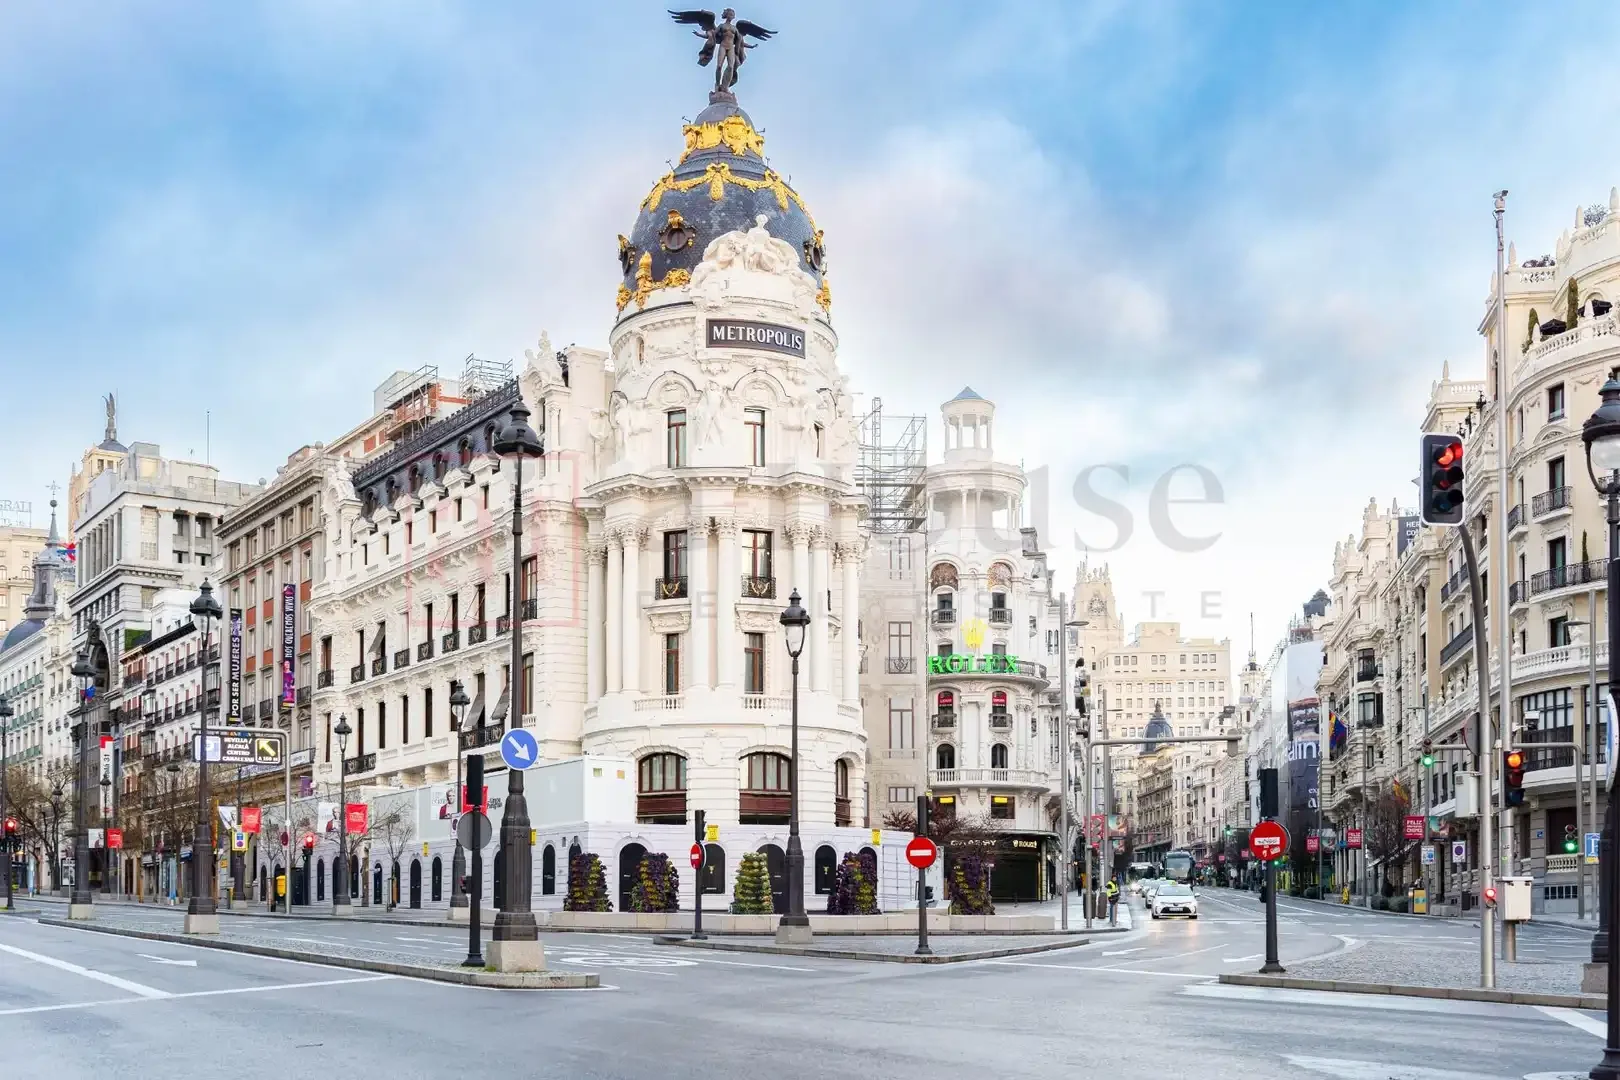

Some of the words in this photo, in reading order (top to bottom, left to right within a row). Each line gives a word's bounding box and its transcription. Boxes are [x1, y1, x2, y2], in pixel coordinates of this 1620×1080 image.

[713, 325, 802, 350] METROPOLIS
[285, 596, 294, 612] VIVAS
[285, 613, 294, 645] QUEREMOS
[232, 637, 240, 680] MUJERES
[285, 646, 293, 658] NOS
[928, 654, 1020, 673] ROLEX
[103, 754, 110, 762] 31
